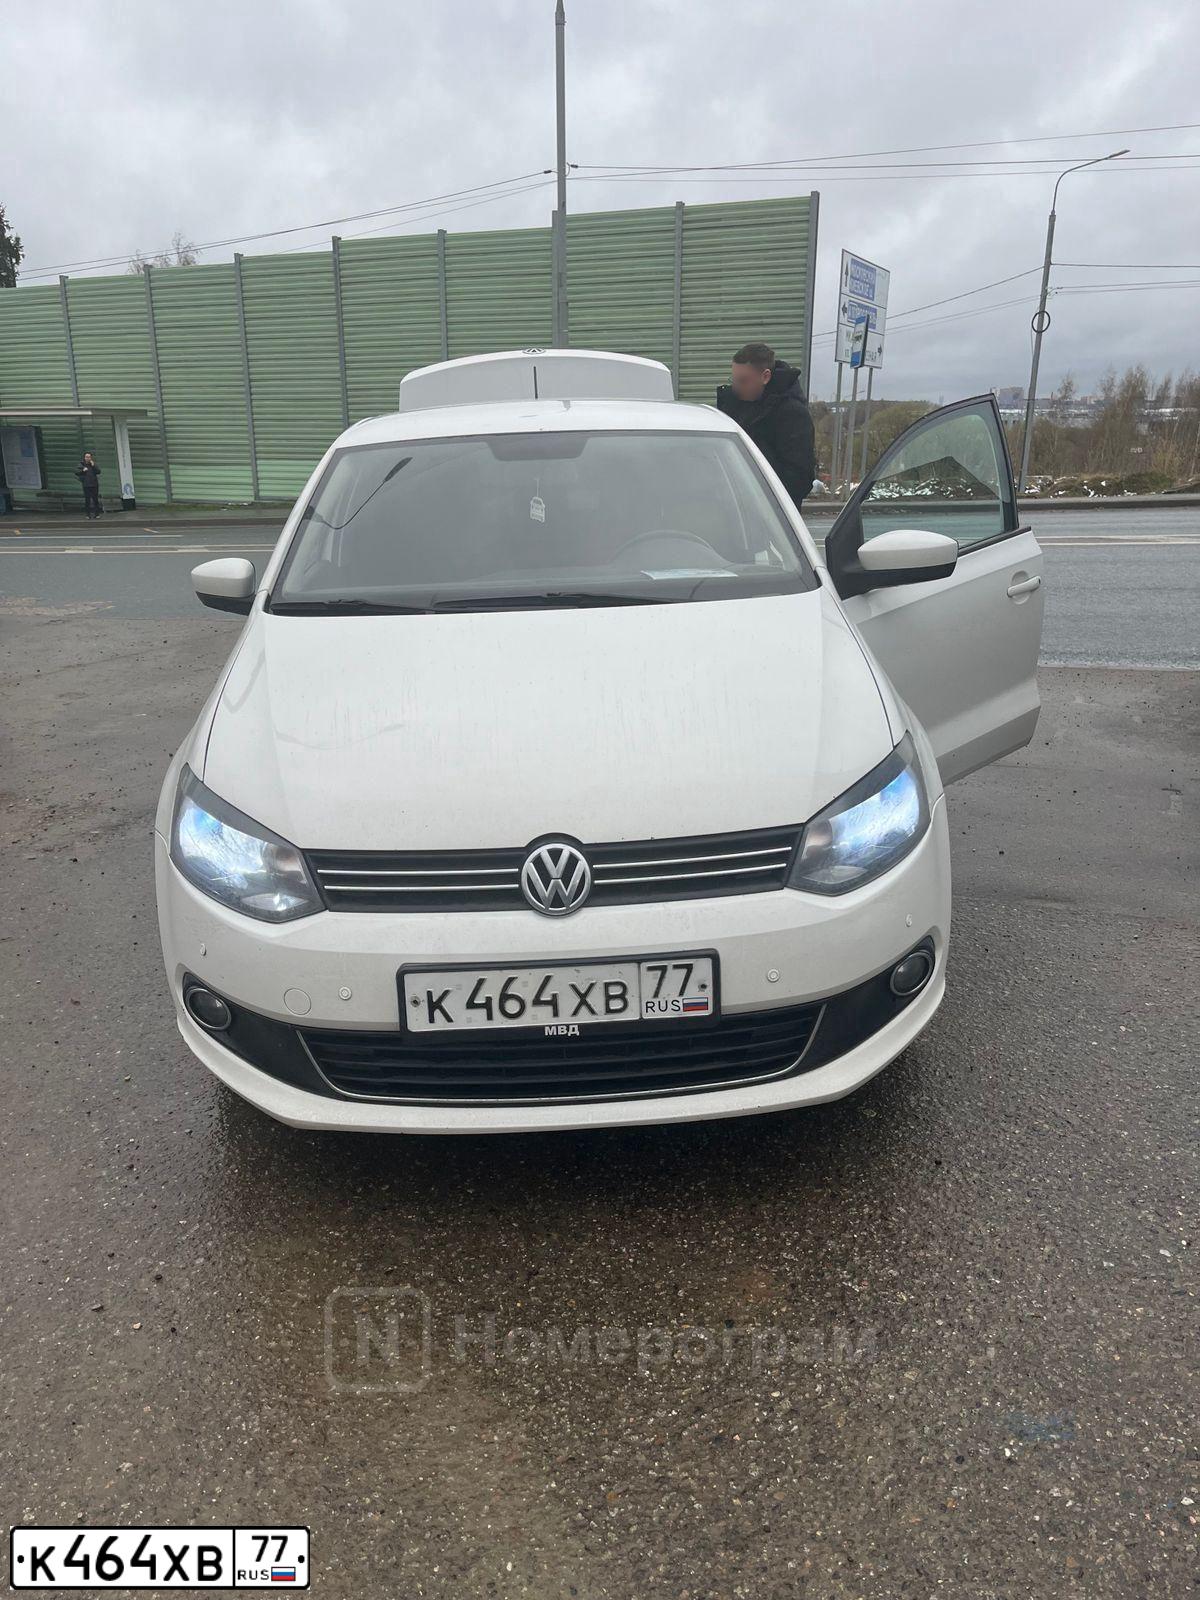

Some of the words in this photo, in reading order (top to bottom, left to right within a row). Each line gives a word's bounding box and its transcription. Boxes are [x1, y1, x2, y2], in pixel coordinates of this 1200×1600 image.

[522, 845, 590, 914] VW
[645, 963, 694, 999] 77
[645, 999, 681, 1014] RUS
[544, 1024, 580, 1037] МВД
